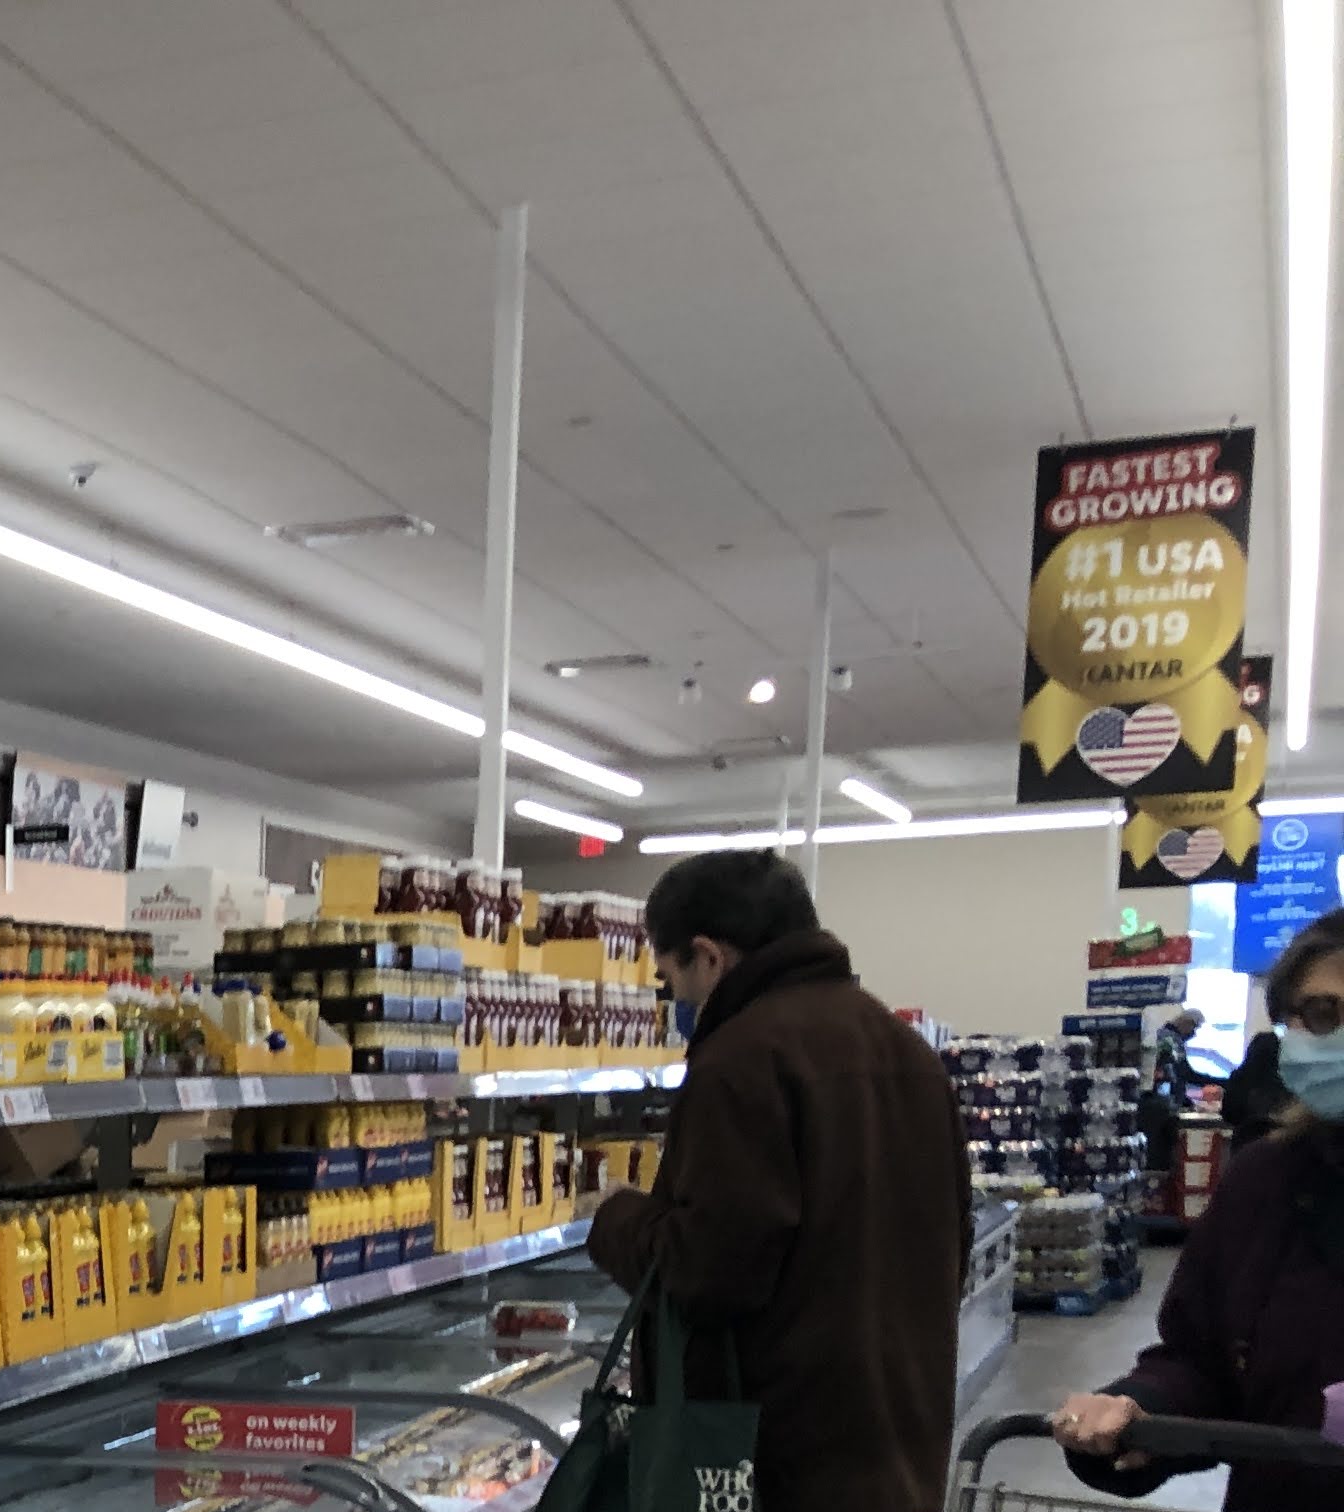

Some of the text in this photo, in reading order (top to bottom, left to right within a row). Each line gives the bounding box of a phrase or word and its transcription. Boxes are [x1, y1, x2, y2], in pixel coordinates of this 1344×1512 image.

[1067, 446, 1215, 495] FASTEST
[1051, 475, 1236, 529] GROWING
[1064, 537, 1225, 582] #1 USA
[1081, 610, 1191, 654] 2019
[246, 1414, 337, 1436] on weekly
[246, 1432, 326, 1452] favorites
